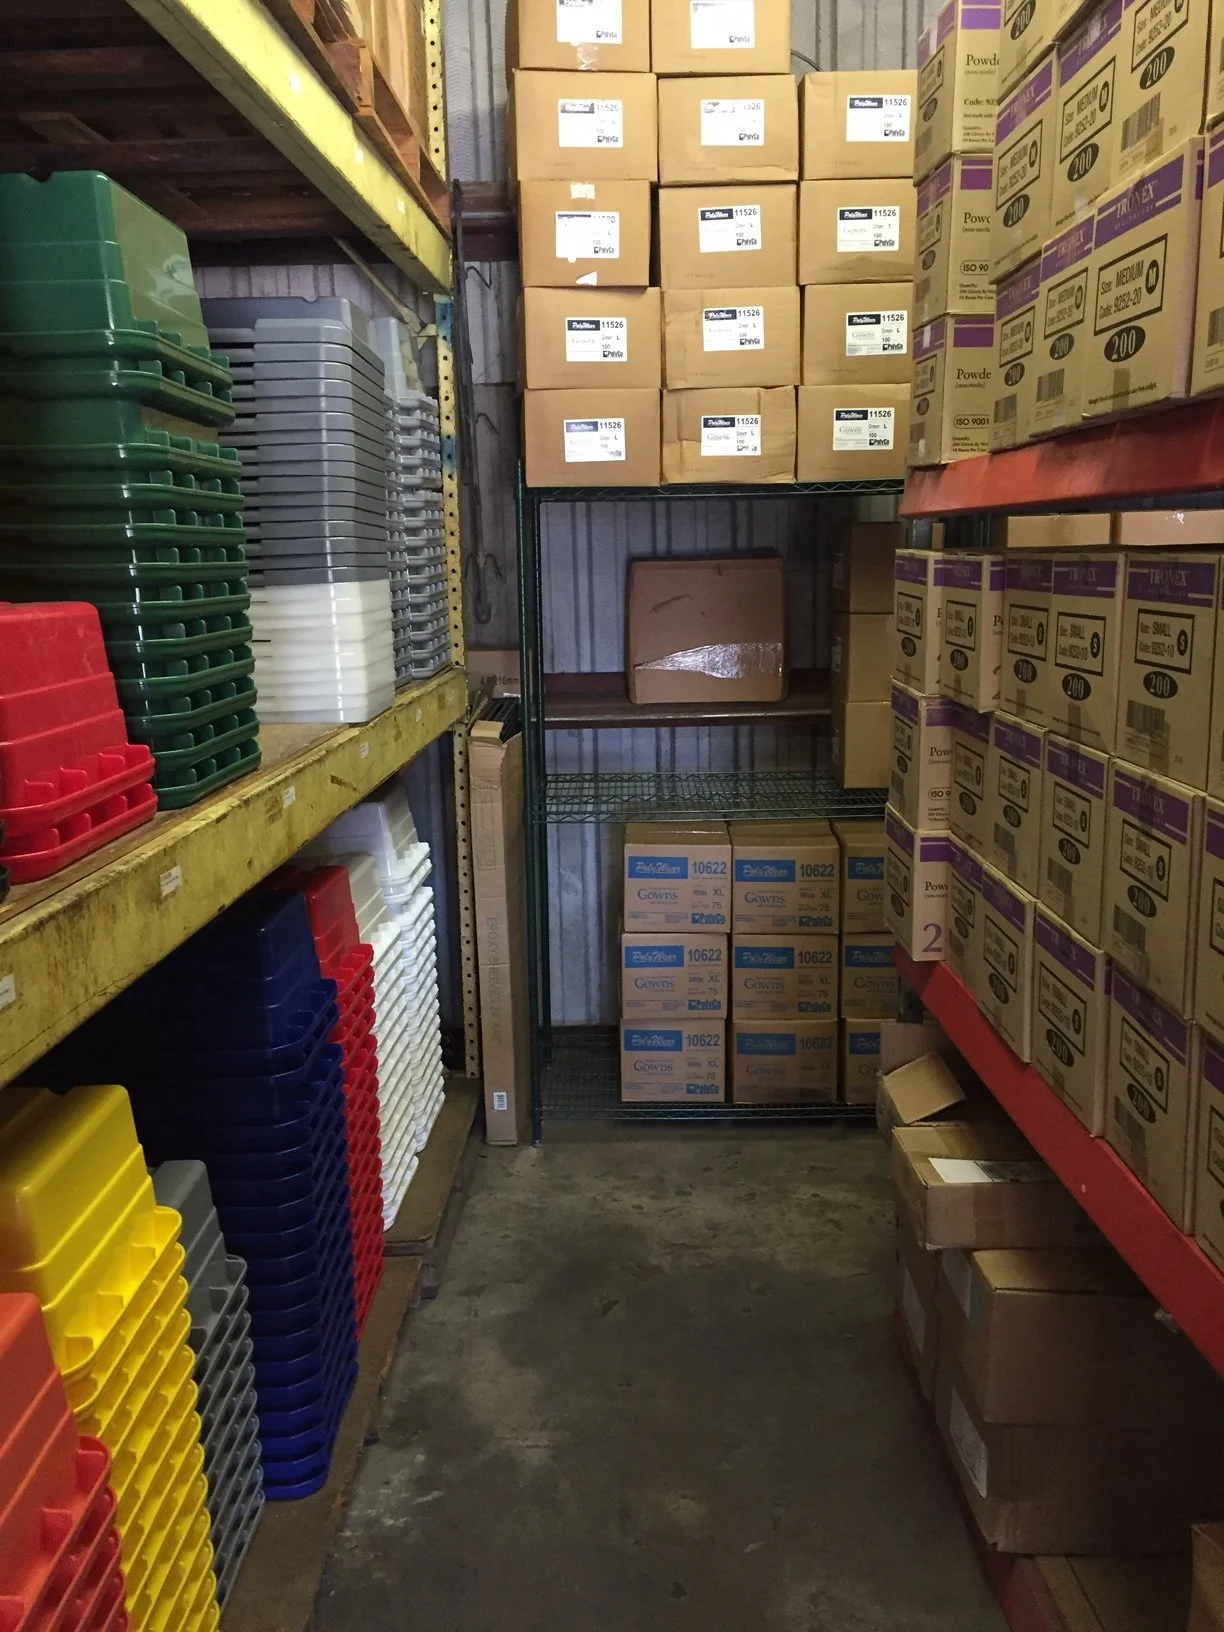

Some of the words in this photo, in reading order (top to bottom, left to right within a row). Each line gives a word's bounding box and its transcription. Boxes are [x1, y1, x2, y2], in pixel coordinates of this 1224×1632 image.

[1146, 53, 1166, 88] 200
[884, 98, 908, 106] 11526
[1076, 84, 1098, 116] MEDIUM
[1073, 148, 1091, 180] 200
[1117, 183, 1154, 218] TRONEX
[734, 208, 757, 216] 11526
[874, 209, 896, 217] 11526
[1008, 197, 1024, 226] 200
[963, 264, 977, 272] ISO
[979, 264, 988, 272] 90
[1148, 267, 1157, 286] M
[1100, 279, 1112, 296] Size:
[1116, 260, 1144, 286] MEDIUM
[1100, 305, 1112, 319] Code:
[1114, 287, 1141, 314] 9252-20
[738, 309, 760, 317] 11526
[882, 314, 904, 322] 11526
[1054, 335, 1069, 358] 200
[1112, 329, 1136, 360] 200
[956, 368, 992, 380] Powde
[1008, 365, 1021, 385] 200
[869, 410, 891, 418] 11526
[1153, 622, 1171, 637] SMALL
[1019, 661, 1033, 681] 200
[1067, 675, 1084, 698] 200
[1150, 674, 1170, 696] 200
[1063, 838, 1077, 863] 200
[691, 861, 727, 875] 10622
[800, 864, 834, 877] 10622
[637, 888, 678, 900] Gowns
[744, 892, 785, 904] Gowns
[1133, 887, 1150, 915] 200
[486, 917, 500, 953] EPOXY
[923, 923, 942, 952] 2
[688, 949, 722, 961] 10622
[798, 952, 832, 964] 10622
[634, 978, 675, 988] Gowns
[744, 978, 784, 990] Gowns
[687, 1034, 720, 1046] 10622
[800, 1037, 833, 1049] 10622
[1051, 1034, 1067, 1062] 200
[634, 1061, 673, 1071] Gowns
[1132, 1088, 1150, 1119] 200
